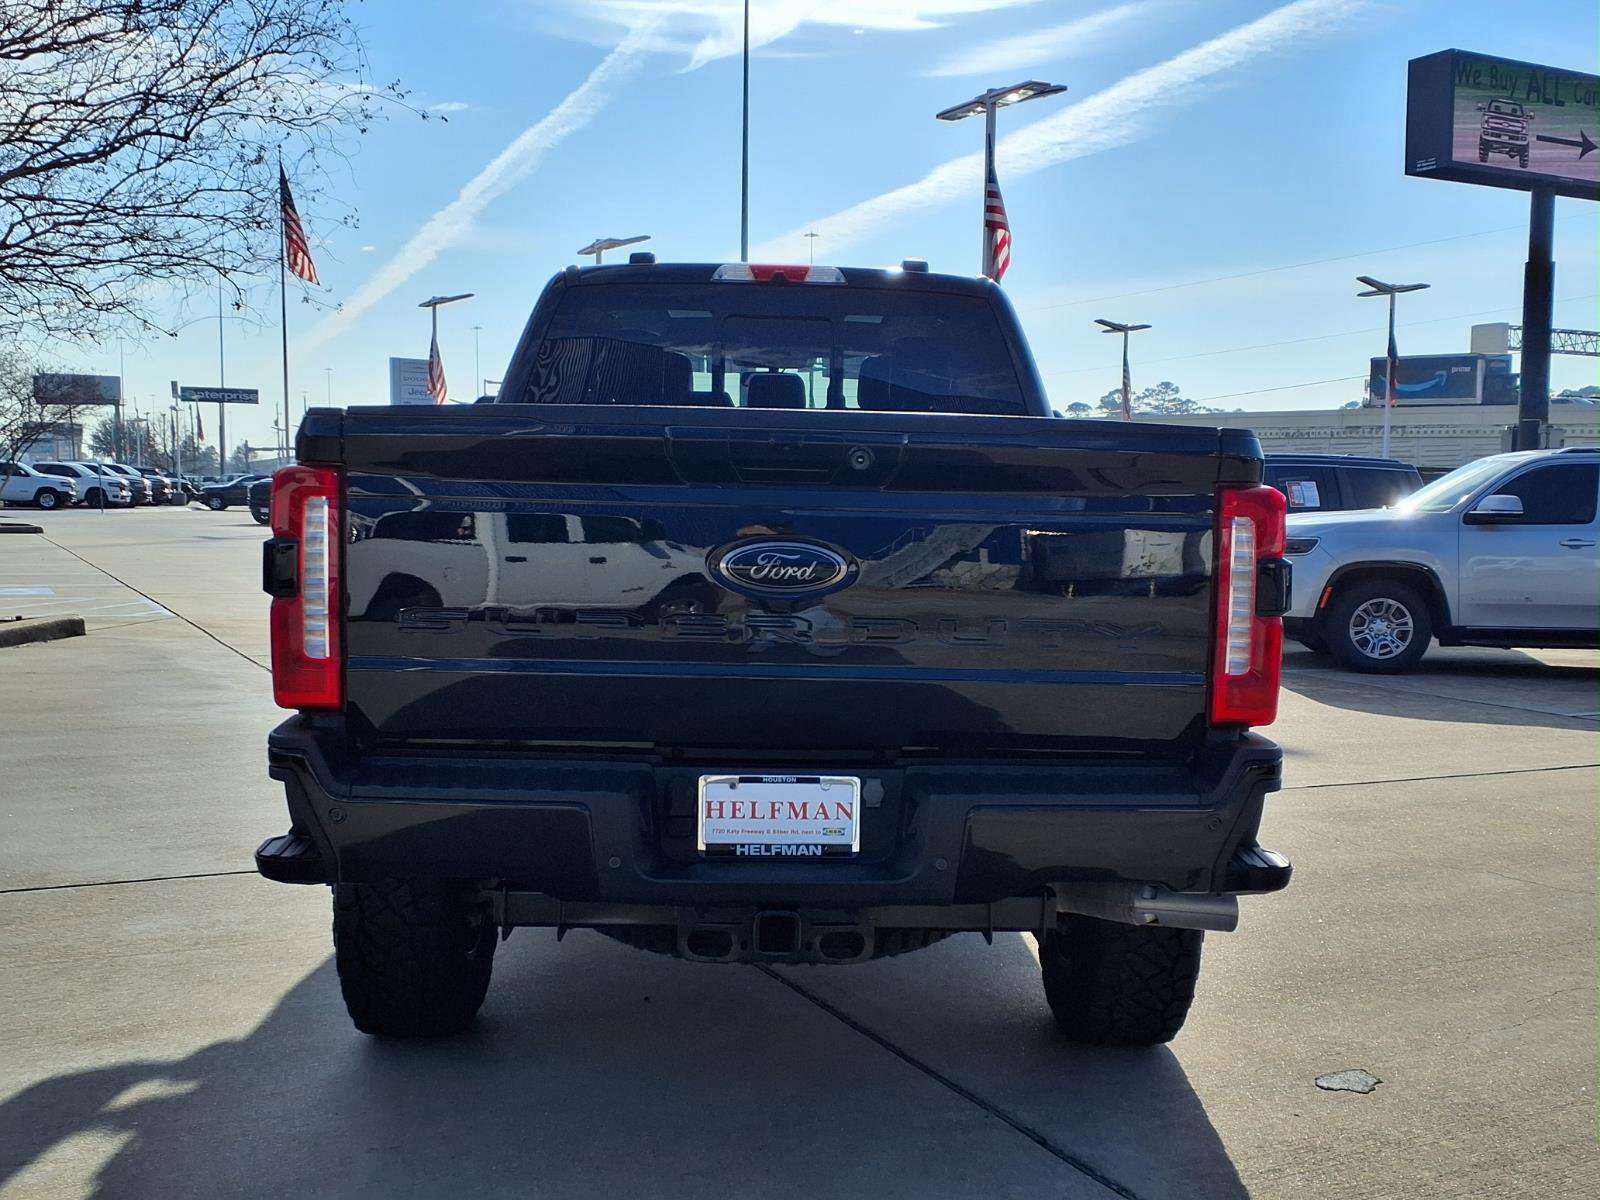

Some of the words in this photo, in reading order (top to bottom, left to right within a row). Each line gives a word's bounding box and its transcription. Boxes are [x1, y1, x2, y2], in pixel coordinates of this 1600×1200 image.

[1455, 60, 1481, 86] We
[1490, 65, 1519, 98] Buy
[1526, 70, 1565, 106] ALL
[750, 552, 816, 581] Ford
[397, 607, 811, 645] SUPER
[851, 616, 1164, 649] DUTY
[762, 776, 797, 784] HOUSTON
[705, 800, 853, 821] HELFMAN
[735, 844, 822, 856] HELFMAN
